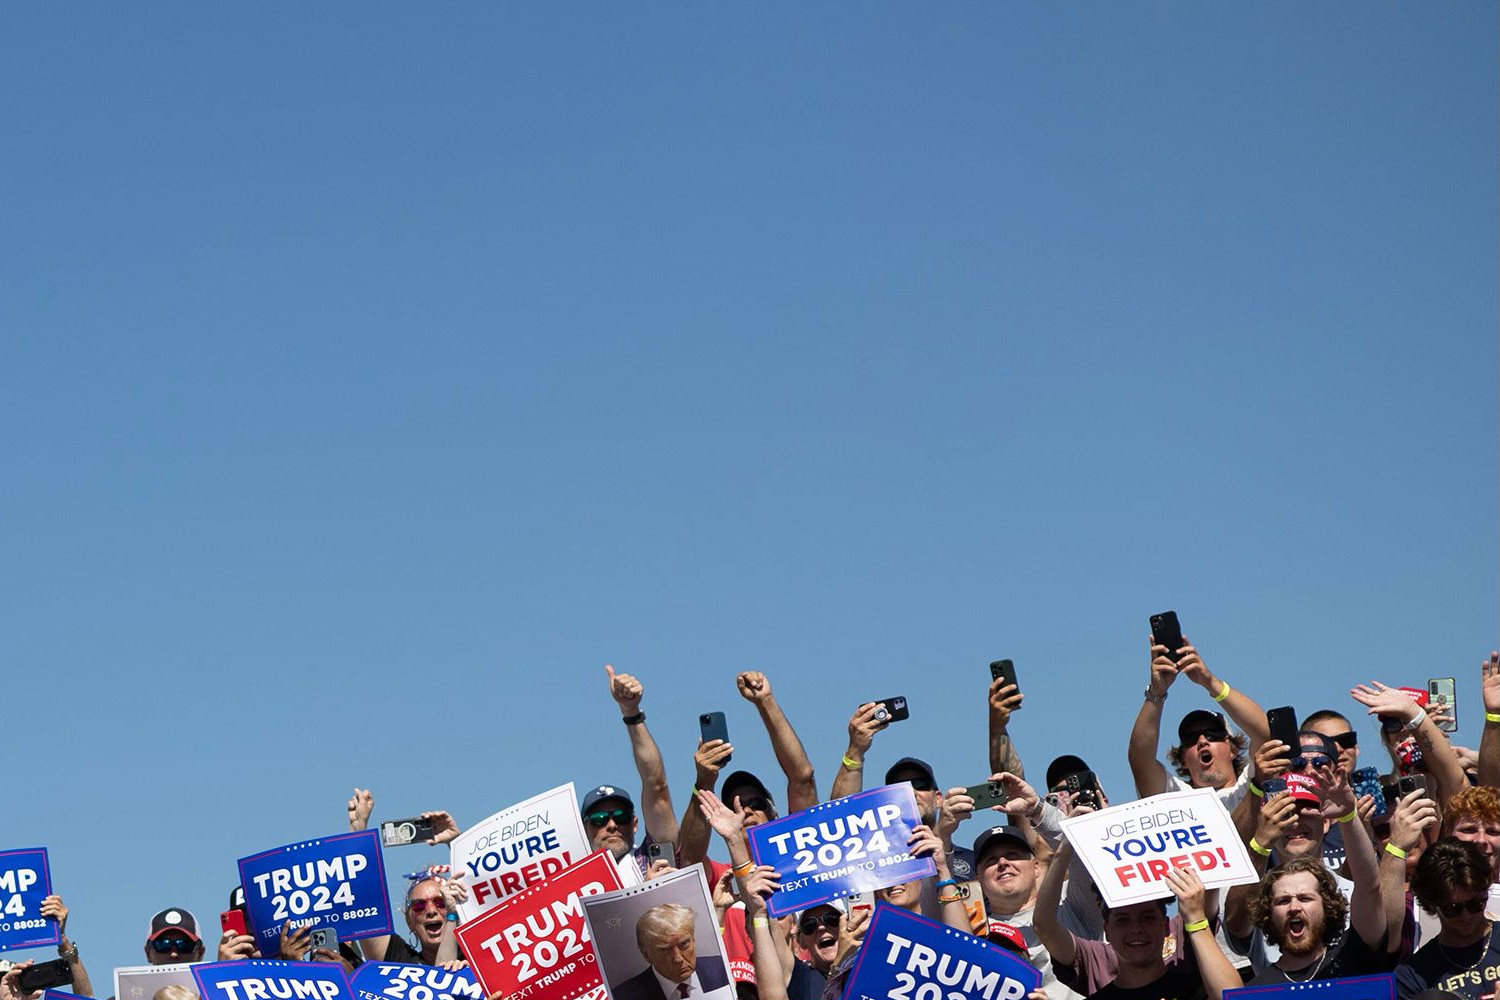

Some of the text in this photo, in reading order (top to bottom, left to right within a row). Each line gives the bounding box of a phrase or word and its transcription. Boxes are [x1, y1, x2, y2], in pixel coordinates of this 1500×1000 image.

[468, 810, 551, 855] JOE BIDEN,
[769, 804, 902, 856] TRUMP
[1101, 807, 1198, 841] JOE BIDEN,
[1101, 825, 1212, 862] YOU'RE
[467, 829, 561, 878] YOU'RE
[794, 833, 891, 875] 2024
[1114, 847, 1230, 888] FIRED!
[253, 853, 367, 898] TRUMP
[472, 851, 572, 906] FIRED!
[779, 860, 875, 893] TEXT TRUMP TO
[271, 882, 355, 921] 2024
[13, 918, 47, 931] 88022
[262, 906, 378, 938] TEXT RUMP TO 88022
[535, 963, 577, 989] TRUMP
[577, 953, 595, 968] TO
[1437, 970, 1482, 991] LET'S
